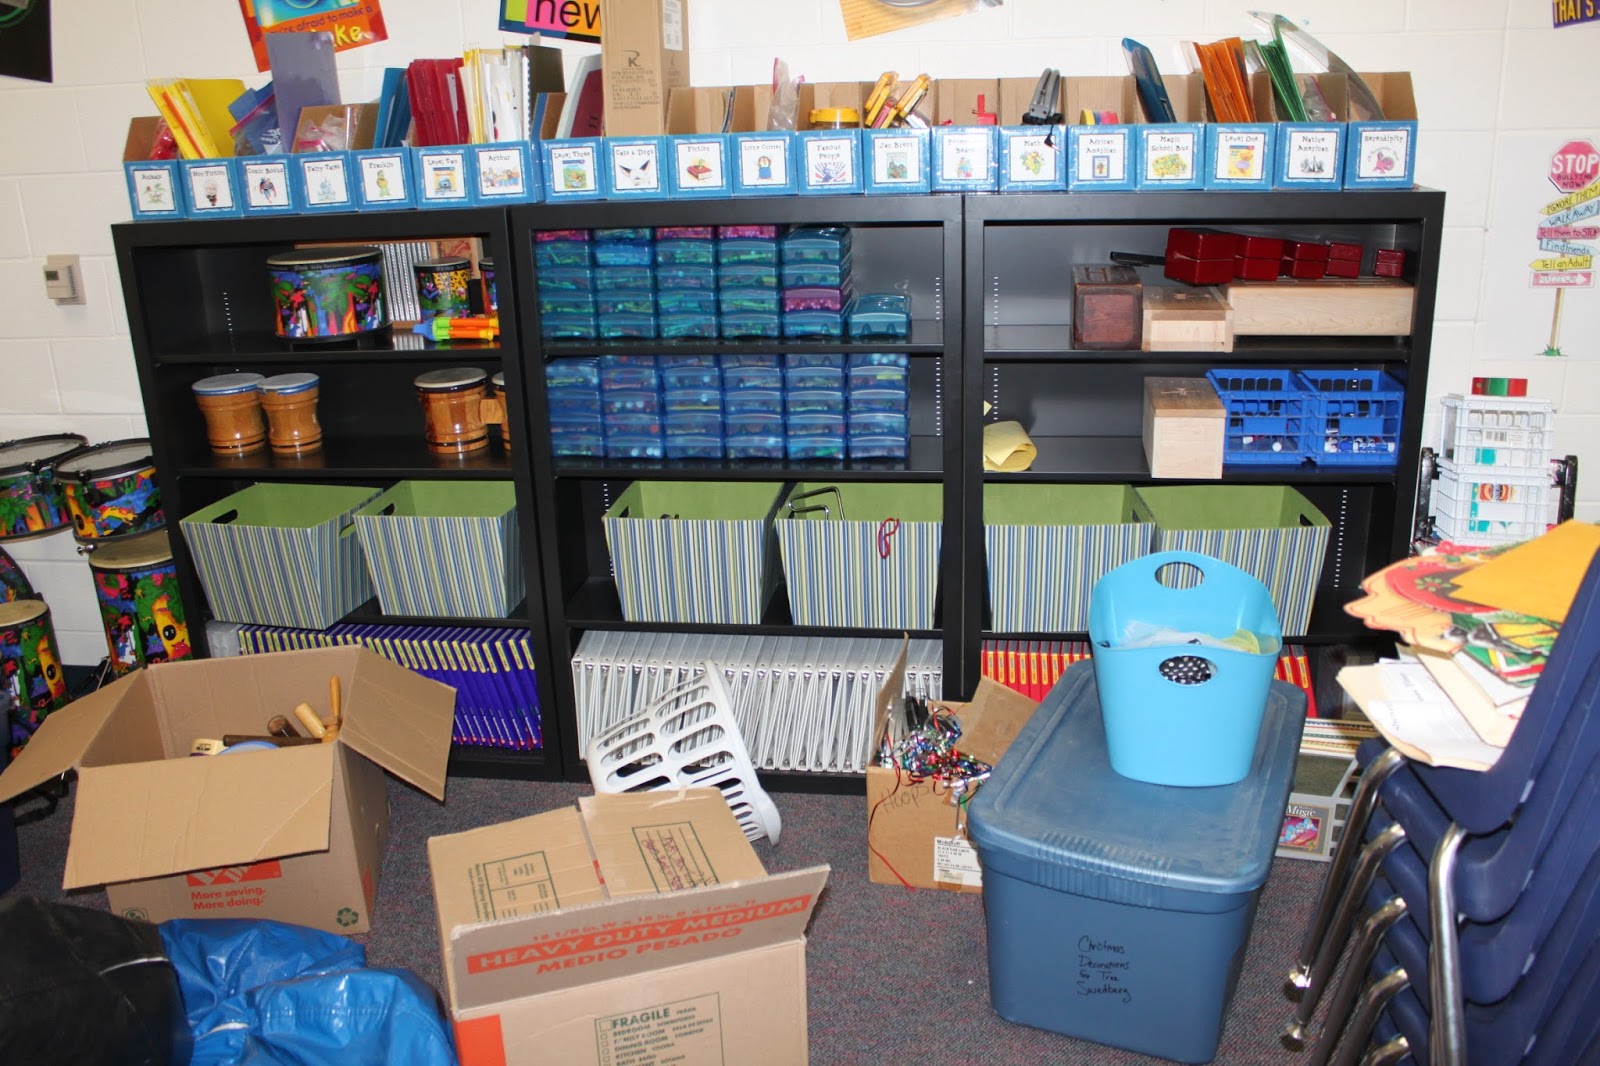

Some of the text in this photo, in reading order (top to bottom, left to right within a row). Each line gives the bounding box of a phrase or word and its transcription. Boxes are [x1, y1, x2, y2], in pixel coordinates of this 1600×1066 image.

[296, 18, 326, 32] afraid
[328, 14, 338, 23] to
[339, 7, 364, 21] make
[1089, 138, 1115, 146] African
[1160, 135, 1180, 143] Magic
[1224, 135, 1244, 143] Level
[1301, 135, 1325, 143] Native
[1364, 135, 1404, 144] Serendipity
[817, 144, 841, 152] Famous
[879, 142, 893, 150] Jan
[1151, 144, 1173, 152] School
[1297, 144, 1329, 152] American
[488, 154, 511, 162] Arthur
[638, 149, 655, 157] Dogs
[369, 161, 395, 170] Franklin
[427, 158, 445, 166] Level
[1552, 154, 1600, 174] STOP
[1557, 173, 1593, 182] BULLYING
[1546, 184, 1600, 214] IGNORE THEM
[1548, 202, 1597, 227] WALK AWAY
[1539, 228, 1553, 238] Tell
[1573, 229, 1582, 237] to
[1582, 226, 1600, 238] STOP
[1546, 239, 1591, 255] Find friends
[1541, 260, 1556, 269] Tell
[1567, 256, 1590, 268] Adult
[881, 784, 930, 815] Hoops
[1286, 804, 1316, 819] Music
[191, 886, 267, 901] More saving.
[193, 896, 265, 910] More doing.
[480, 900, 804, 968] HEAVY DUTY MEDIUM
[536, 926, 744, 975] MEDIO PESADO
[612, 1007, 671, 1030] FRAGILE
[613, 1024, 650, 1036] BEDROOM
[614, 1034, 640, 1045] FMILY
[614, 1040, 643, 1052] DINING
[643, 1036, 669, 1045] ROOM
[616, 1048, 647, 1059] KITCHEN
